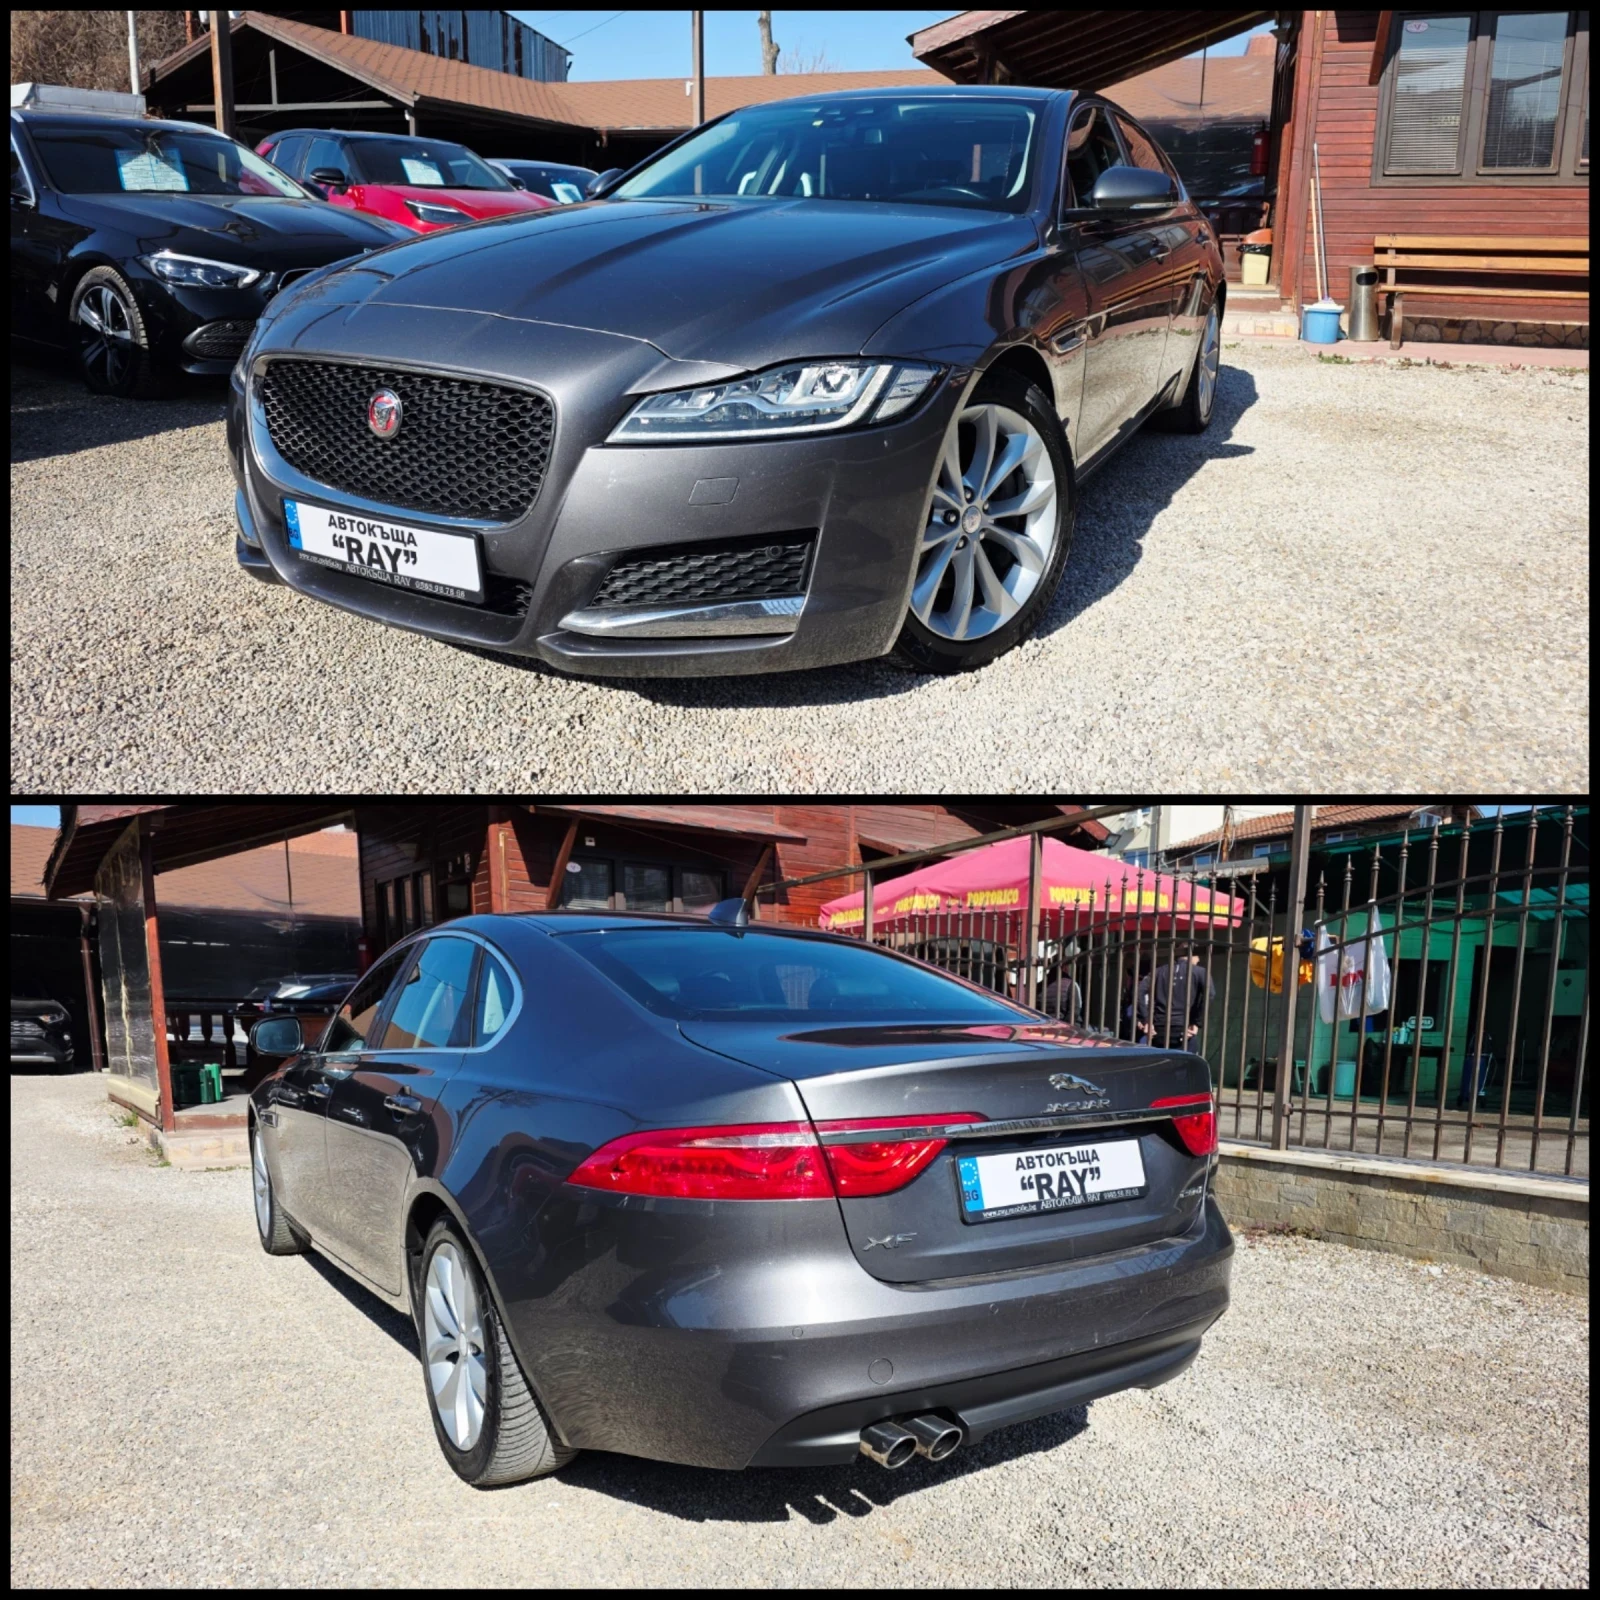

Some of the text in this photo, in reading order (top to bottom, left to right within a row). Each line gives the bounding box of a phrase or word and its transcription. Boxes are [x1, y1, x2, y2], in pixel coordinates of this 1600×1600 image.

[328, 514, 418, 547] АВТОКЪЩА
[346, 563, 392, 583] АВТОКЪЩА
[393, 574, 411, 586] RAY
[966, 888, 1019, 907] PORTORICO
[1040, 1099, 1111, 1114] JAGUAR
[1015, 1149, 1100, 1171] АВТОКЪЩА
[964, 1189, 979, 1201] BG
[863, 1232, 917, 1251] XF
